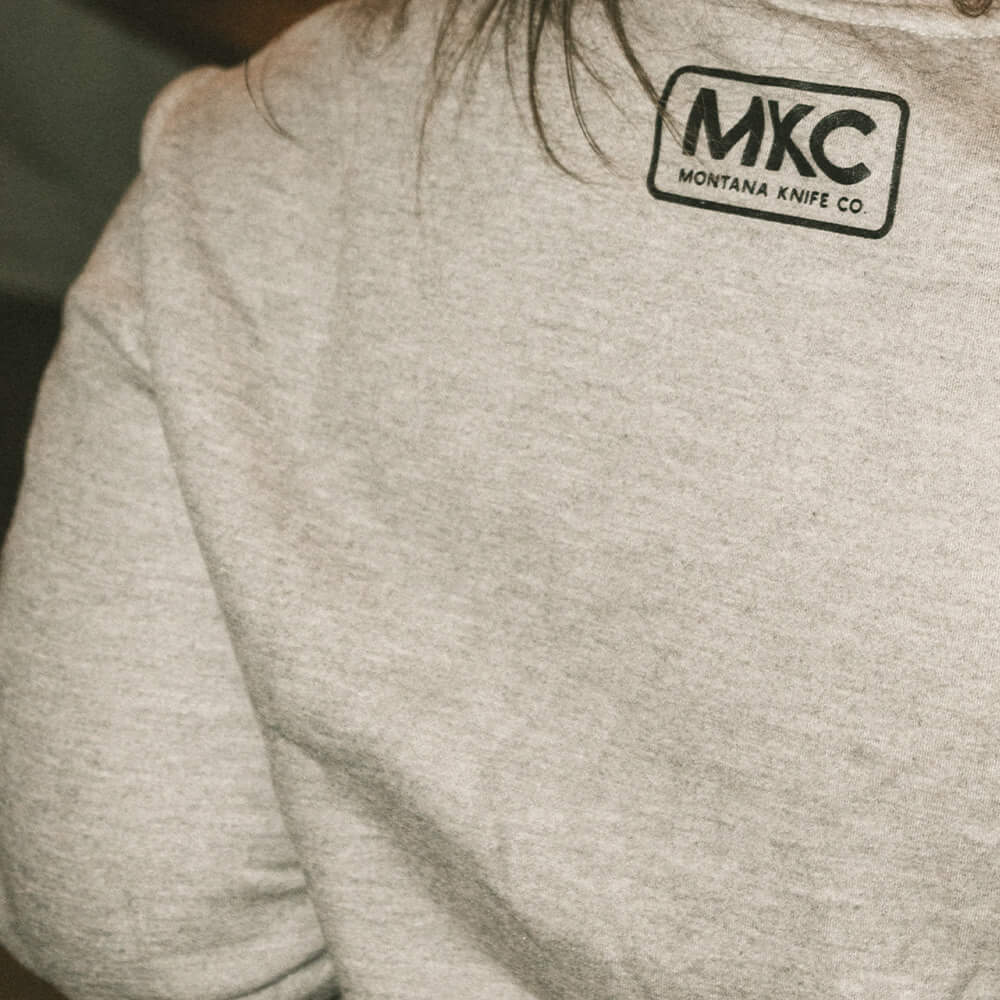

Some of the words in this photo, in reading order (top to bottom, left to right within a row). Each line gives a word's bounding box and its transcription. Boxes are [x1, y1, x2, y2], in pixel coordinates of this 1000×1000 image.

[682, 87, 877, 186] MKC
[678, 168, 768, 197] MONTANA
[777, 186, 830, 209] KNIFE
